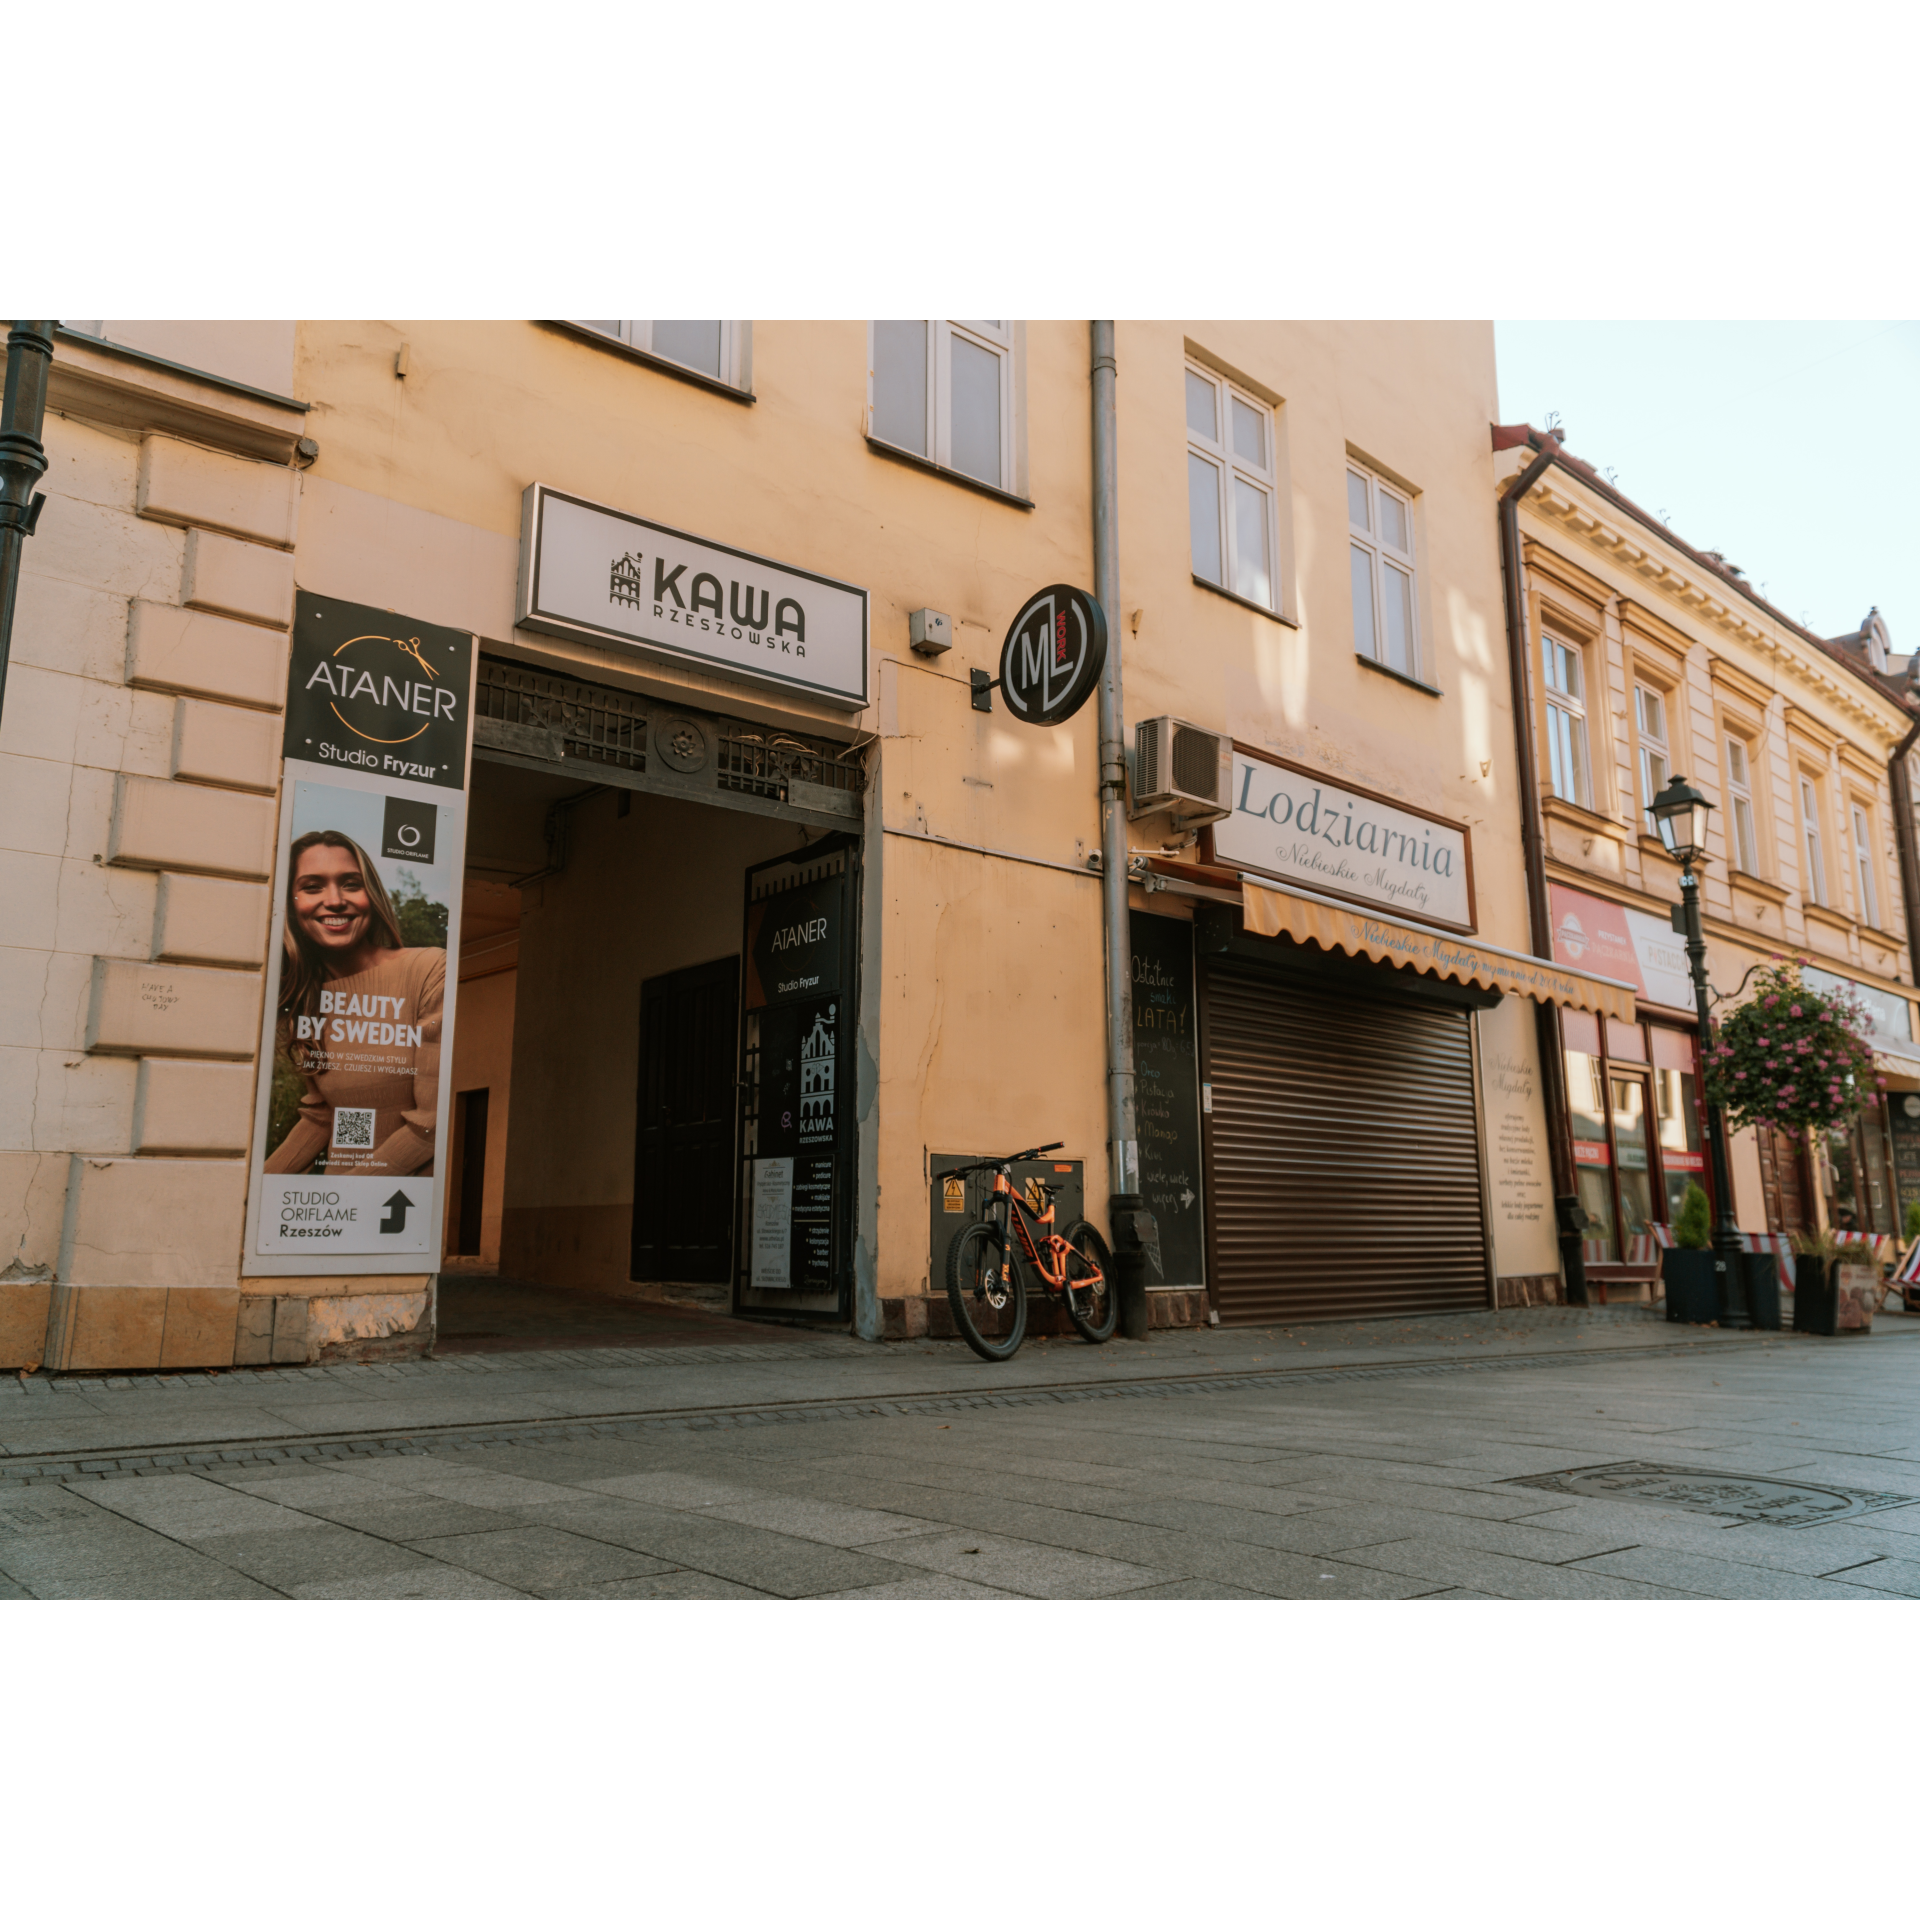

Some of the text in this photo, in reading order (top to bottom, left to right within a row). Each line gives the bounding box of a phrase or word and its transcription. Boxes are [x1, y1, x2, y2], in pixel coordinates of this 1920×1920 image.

[653, 556, 806, 643] KAWA
[653, 604, 806, 658] RZESZOWSKA
[1056, 610, 1067, 663] WORK
[305, 661, 457, 722] ATANER
[318, 742, 436, 779] Studio Fryzur
[1235, 763, 1453, 878] Lodziarnia
[405, 850, 429, 859] ORIFLAME
[1275, 842, 1430, 909] Niebieskie Migdały
[771, 917, 827, 953] ATANER
[1598, 929, 1627, 946] PRZYSTANEK
[1350, 921, 1420, 955] Niebieskie
[1423, 939, 1480, 976] Migdały
[1591, 942, 1636, 965] PĄCZKARNIA
[1131, 955, 1175, 987] Ostatnie
[777, 975, 820, 994] Studio Fryzur
[1150, 988, 1177, 1005] smaki
[319, 990, 406, 1020] BEAUTY
[1137, 1003, 1187, 1034] LATA!
[296, 1015, 422, 1048] BY SWEDEN
[302, 1060, 315, 1069] JAK
[316, 1061, 342, 1071] ŻYJESZ,
[344, 1063, 372, 1073] CZUJESZ
[377, 1066, 418, 1076] WYGLĄDASZ
[310, 1050, 407, 1064] PIĘKNO W SZWEDZKIM STYLU
[1488, 1053, 1534, 1076] Niebieskie
[1140, 1078, 1175, 1104] Pistacja
[1491, 1072, 1533, 1102] Migdały
[799, 1116, 834, 1134] KAWA
[1144, 1120, 1178, 1145] Mango
[798, 1134, 833, 1144] RZESZOWSKA
[330, 1152, 354, 1160] Zeskanuj
[1170, 1170, 1190, 1186] wiele
[282, 1191, 340, 1206] STUDIO
[280, 1208, 358, 1222] ORIFLAME
[280, 1224, 343, 1238] Rzeszów
[1715, 1260, 1727, 1272] 28
